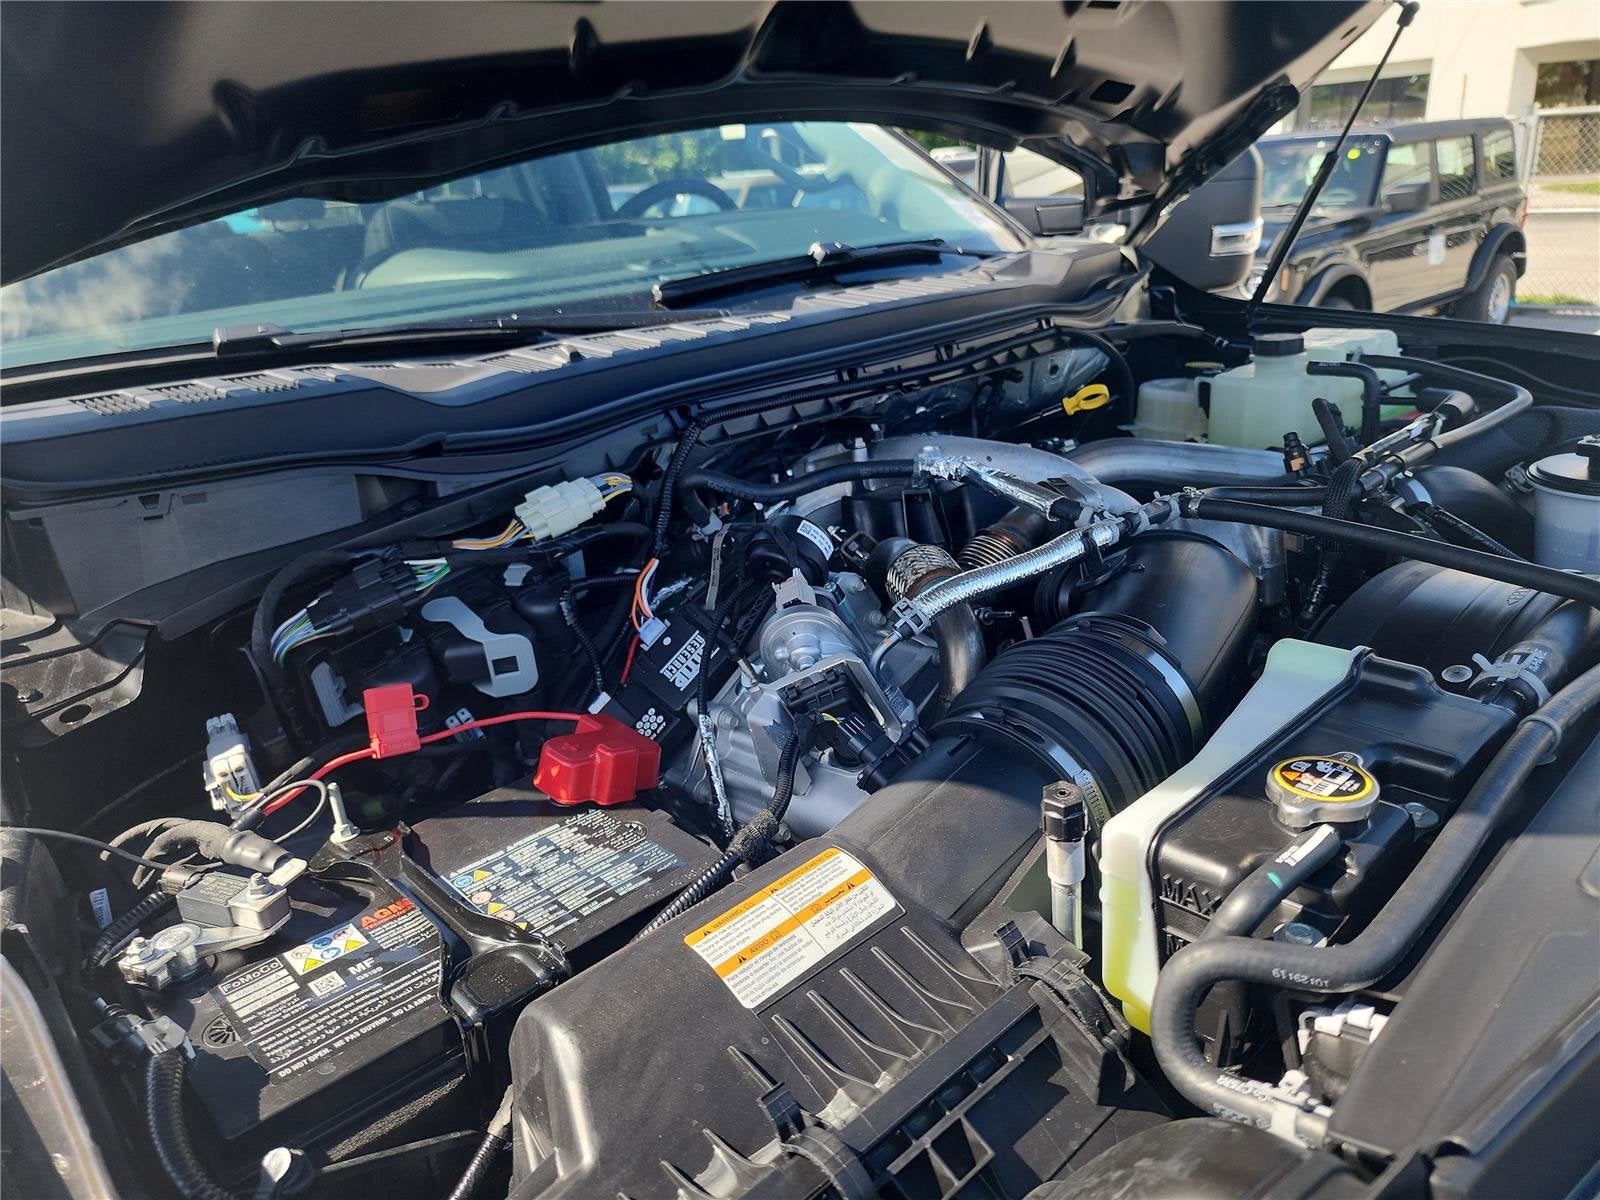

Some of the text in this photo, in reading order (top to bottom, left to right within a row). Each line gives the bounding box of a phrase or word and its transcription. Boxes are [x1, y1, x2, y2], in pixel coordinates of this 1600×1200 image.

[662, 634, 705, 679] RESEARCH
[1162, 873, 1221, 918] MAX
[711, 907, 743, 930] WARNING
[748, 937, 770, 954] AVISO
[221, 960, 280, 992] FoMoCo
[348, 957, 376, 975] MF
[391, 991, 435, 1018] NO LA ABRA.
[332, 1014, 391, 1049] NE PAS OUVRIR.
[278, 1045, 333, 1078] DO NOT OPEN.
